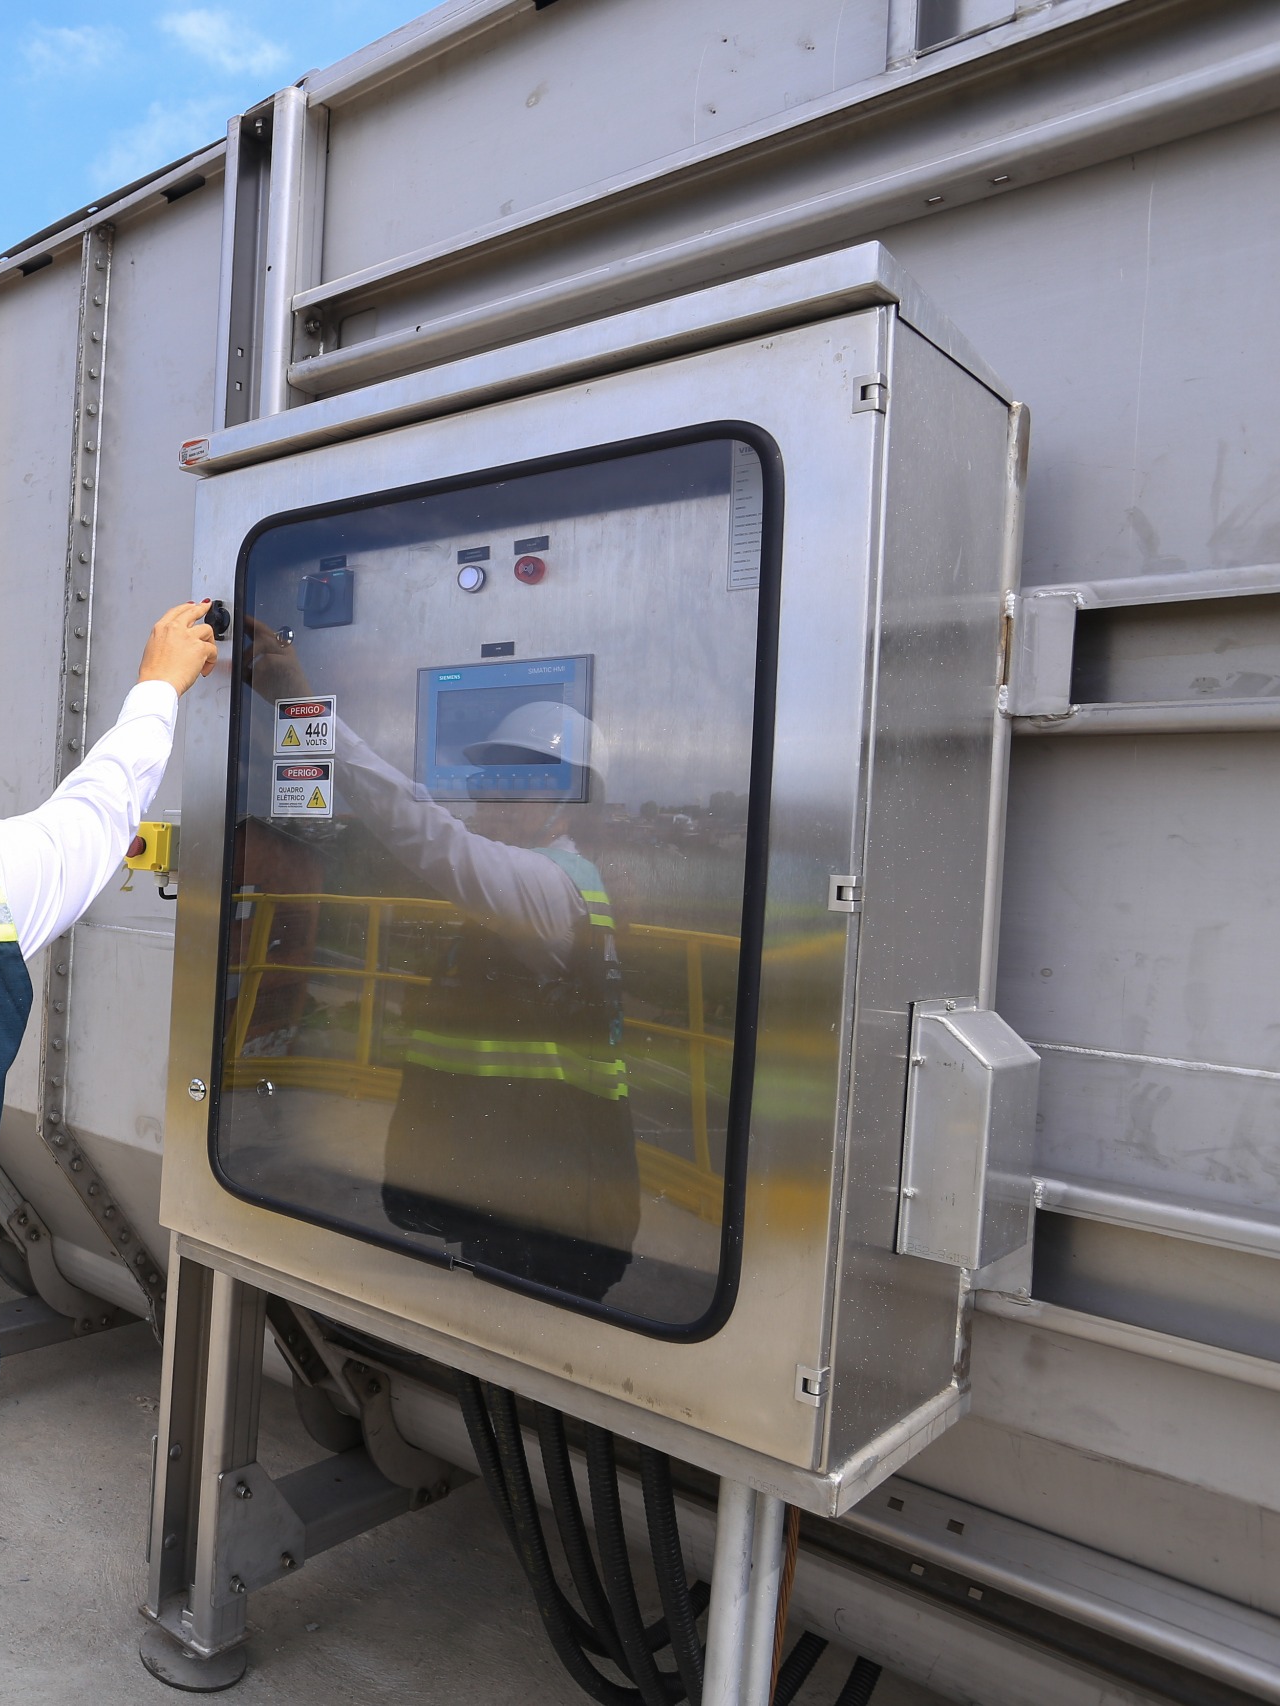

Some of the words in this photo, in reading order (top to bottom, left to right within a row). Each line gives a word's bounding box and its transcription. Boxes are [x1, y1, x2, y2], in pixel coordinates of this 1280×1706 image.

[527, 666, 552, 675] SIMATIC
[552, 665, 566, 673] HMI
[438, 674, 461, 682] SIEMENS
[290, 705, 320, 715] PERIGO
[305, 722, 328, 738] 440
[287, 768, 318, 777] PERIGO
[278, 786, 304, 794] QUADRO
[276, 793, 306, 801] ELÉTRICO
